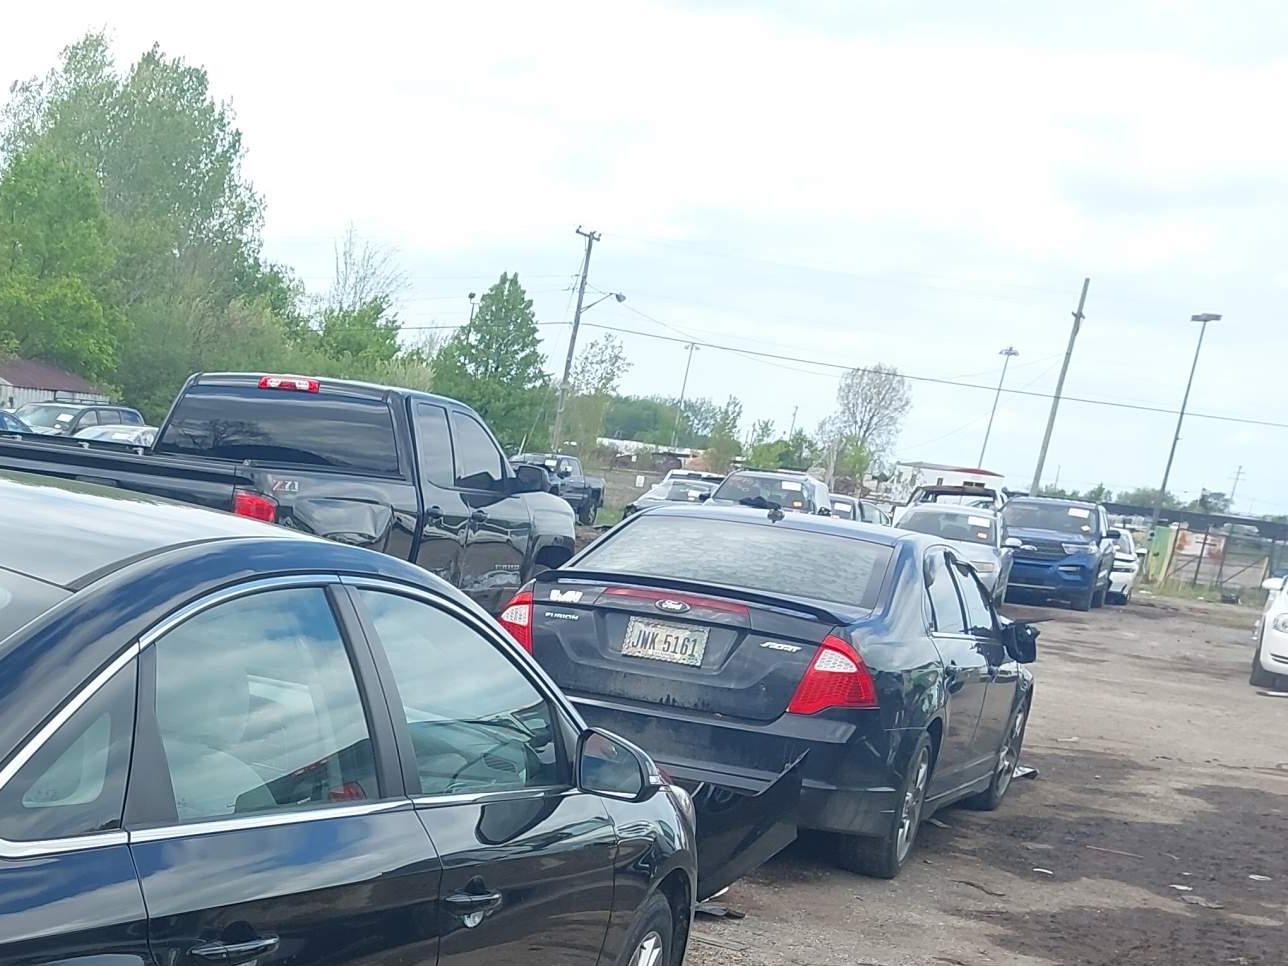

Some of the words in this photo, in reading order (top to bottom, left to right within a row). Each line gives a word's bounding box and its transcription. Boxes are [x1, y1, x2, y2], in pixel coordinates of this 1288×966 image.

[272, 480, 298, 492] Z71
[631, 629, 659, 651] JWK
[662, 634, 698, 657] 5161
